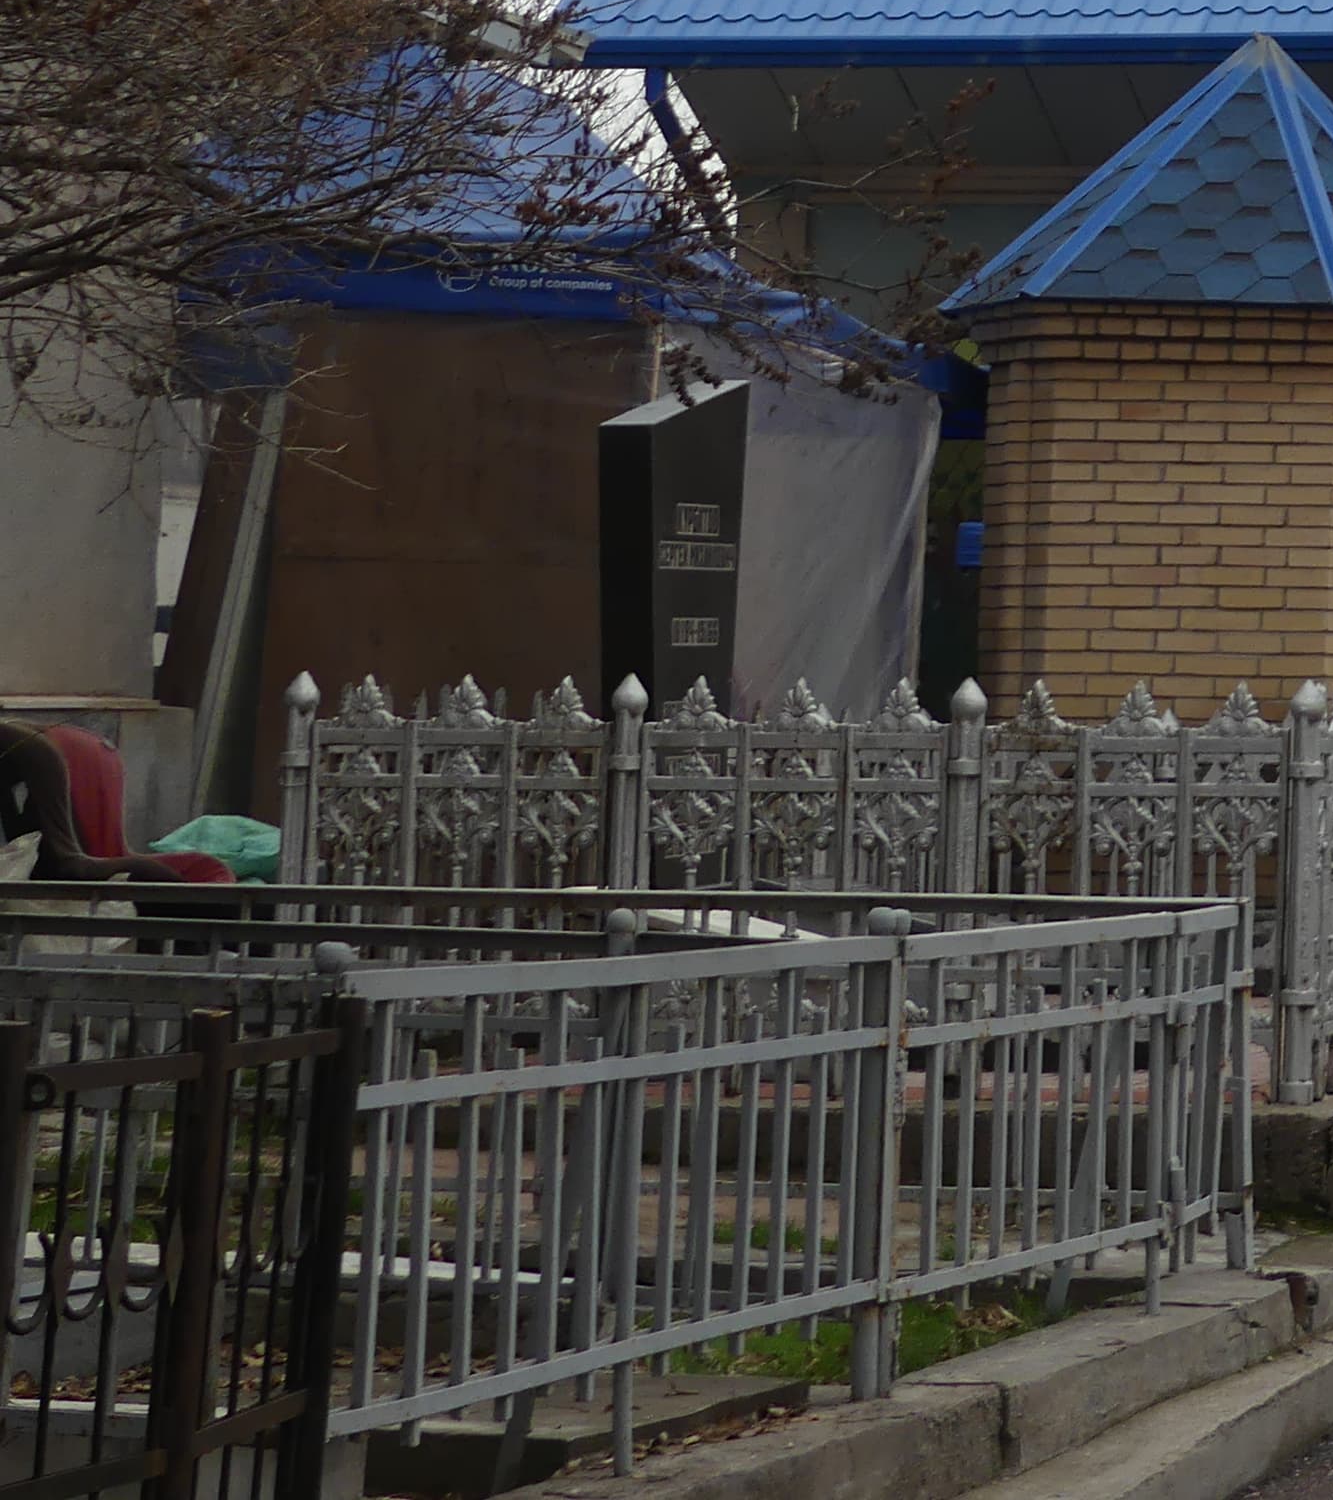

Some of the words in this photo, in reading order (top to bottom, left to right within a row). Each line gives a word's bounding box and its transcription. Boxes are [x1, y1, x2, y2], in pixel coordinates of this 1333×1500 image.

[489, 275, 528, 290] Group
[529, 277, 543, 289] of
[545, 279, 613, 292] companies
